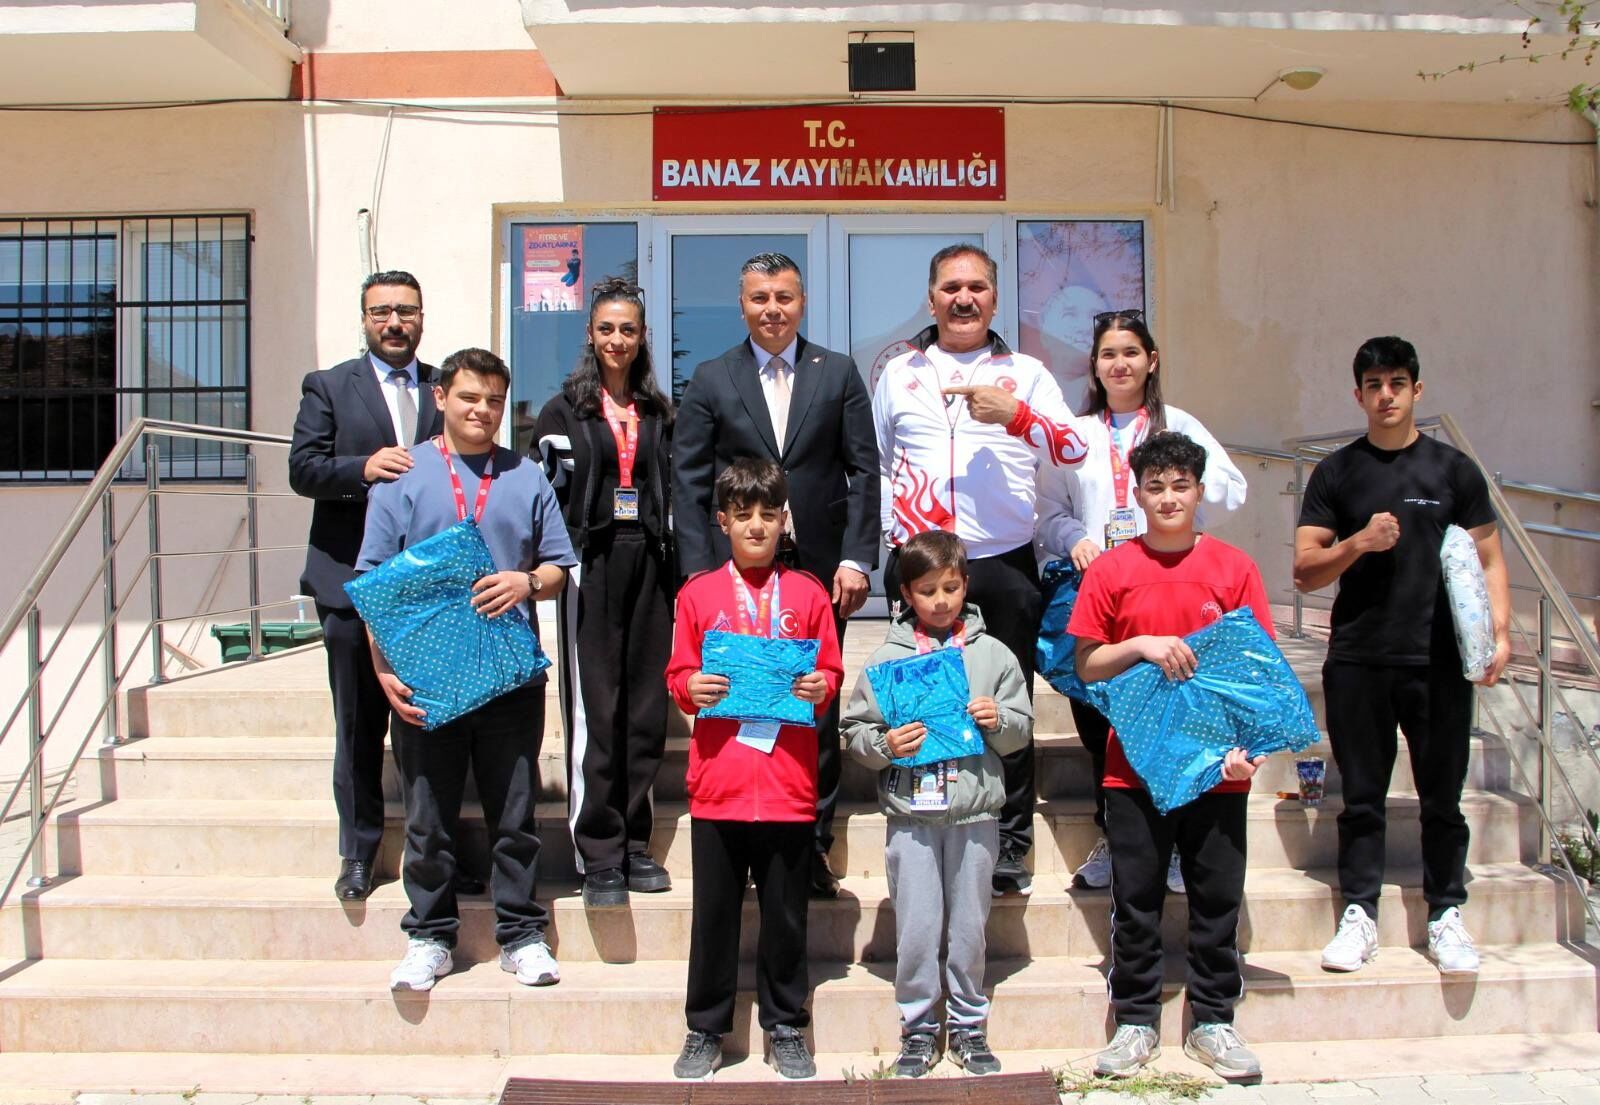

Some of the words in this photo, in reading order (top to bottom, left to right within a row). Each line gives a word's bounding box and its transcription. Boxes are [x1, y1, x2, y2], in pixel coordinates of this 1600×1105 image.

[803, 120, 855, 147] T.C.
[662, 159, 761, 186] BANAZ
[770, 152, 997, 187] KAYMAKAMLIĞI
